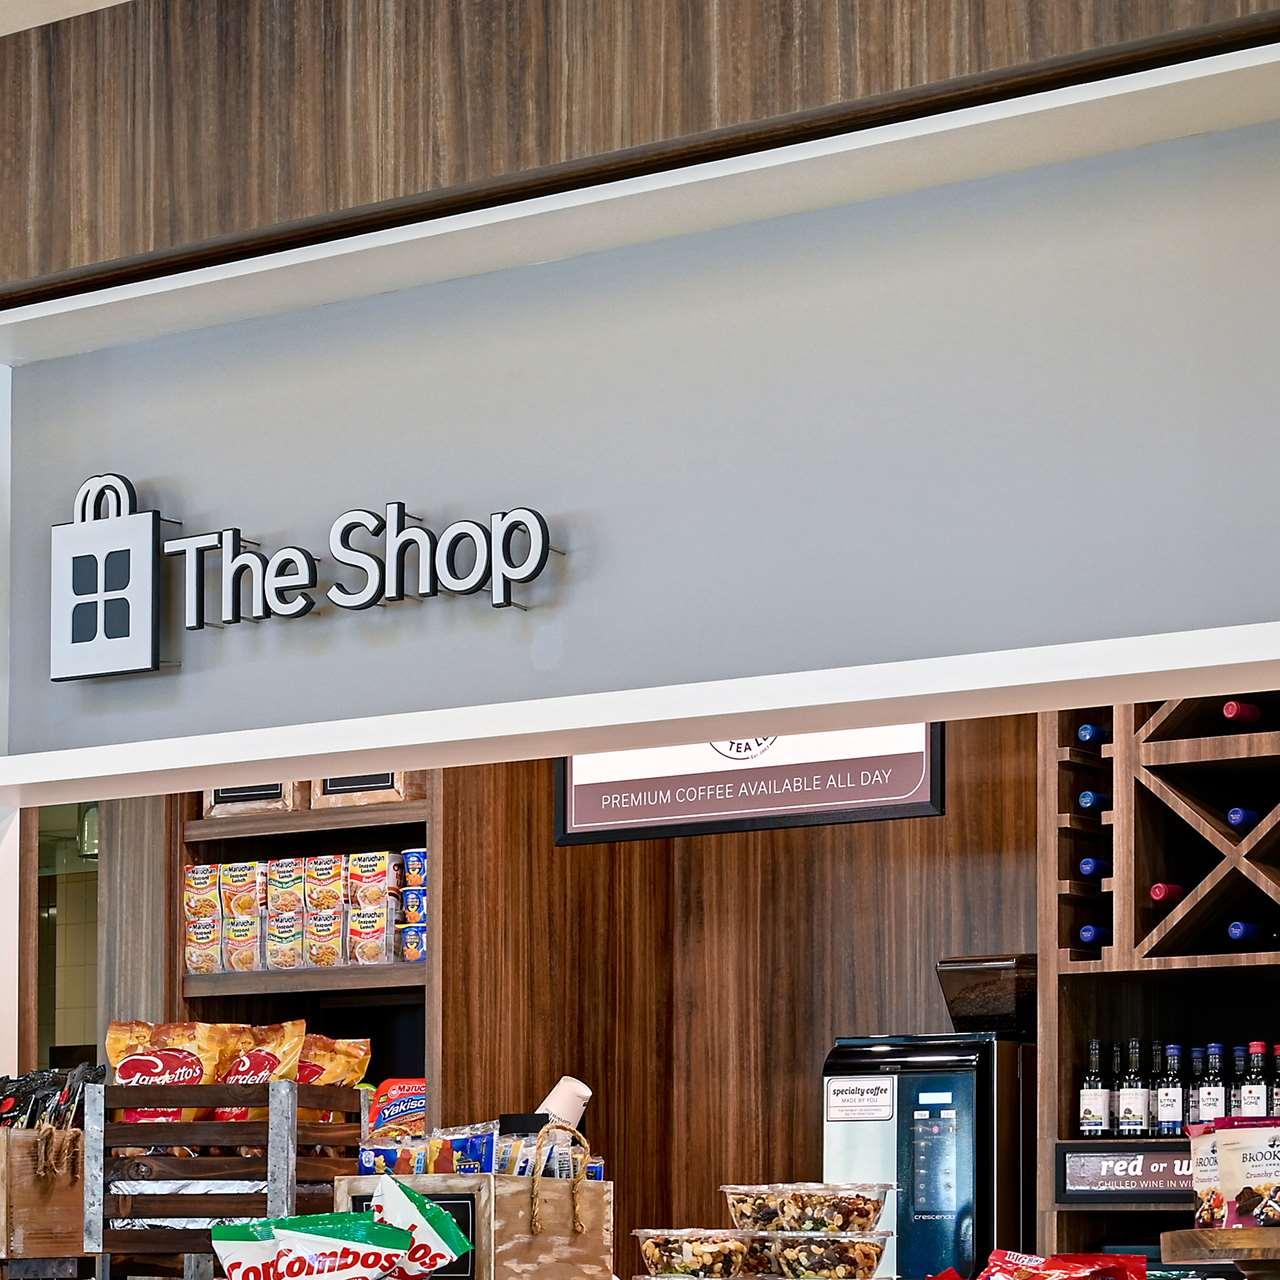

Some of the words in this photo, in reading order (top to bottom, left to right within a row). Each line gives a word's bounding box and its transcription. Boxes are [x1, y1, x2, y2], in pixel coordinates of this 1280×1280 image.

[164, 527, 317, 632] The
[326, 500, 551, 610] Shop
[728, 741, 753, 754] TEA
[601, 790, 672, 809] PREMIUM
[675, 784, 734, 802] COFFEE
[738, 776, 822, 797] AVAILABLE
[825, 772, 856, 789] ALL
[860, 768, 892, 785] DAY
[397, 1084, 426, 1094] Maruc
[832, 1086, 865, 1097] specialty
[866, 1086, 888, 1096] coffee
[383, 1098, 426, 1120] Yakiso
[1100, 1155, 1144, 1177] red
[1150, 1162, 1168, 1173] or
[1098, 1180, 1137, 1189] CHILLED
[1139, 1180, 1164, 1188] WINE
[1166, 1180, 1177, 1188] IN
